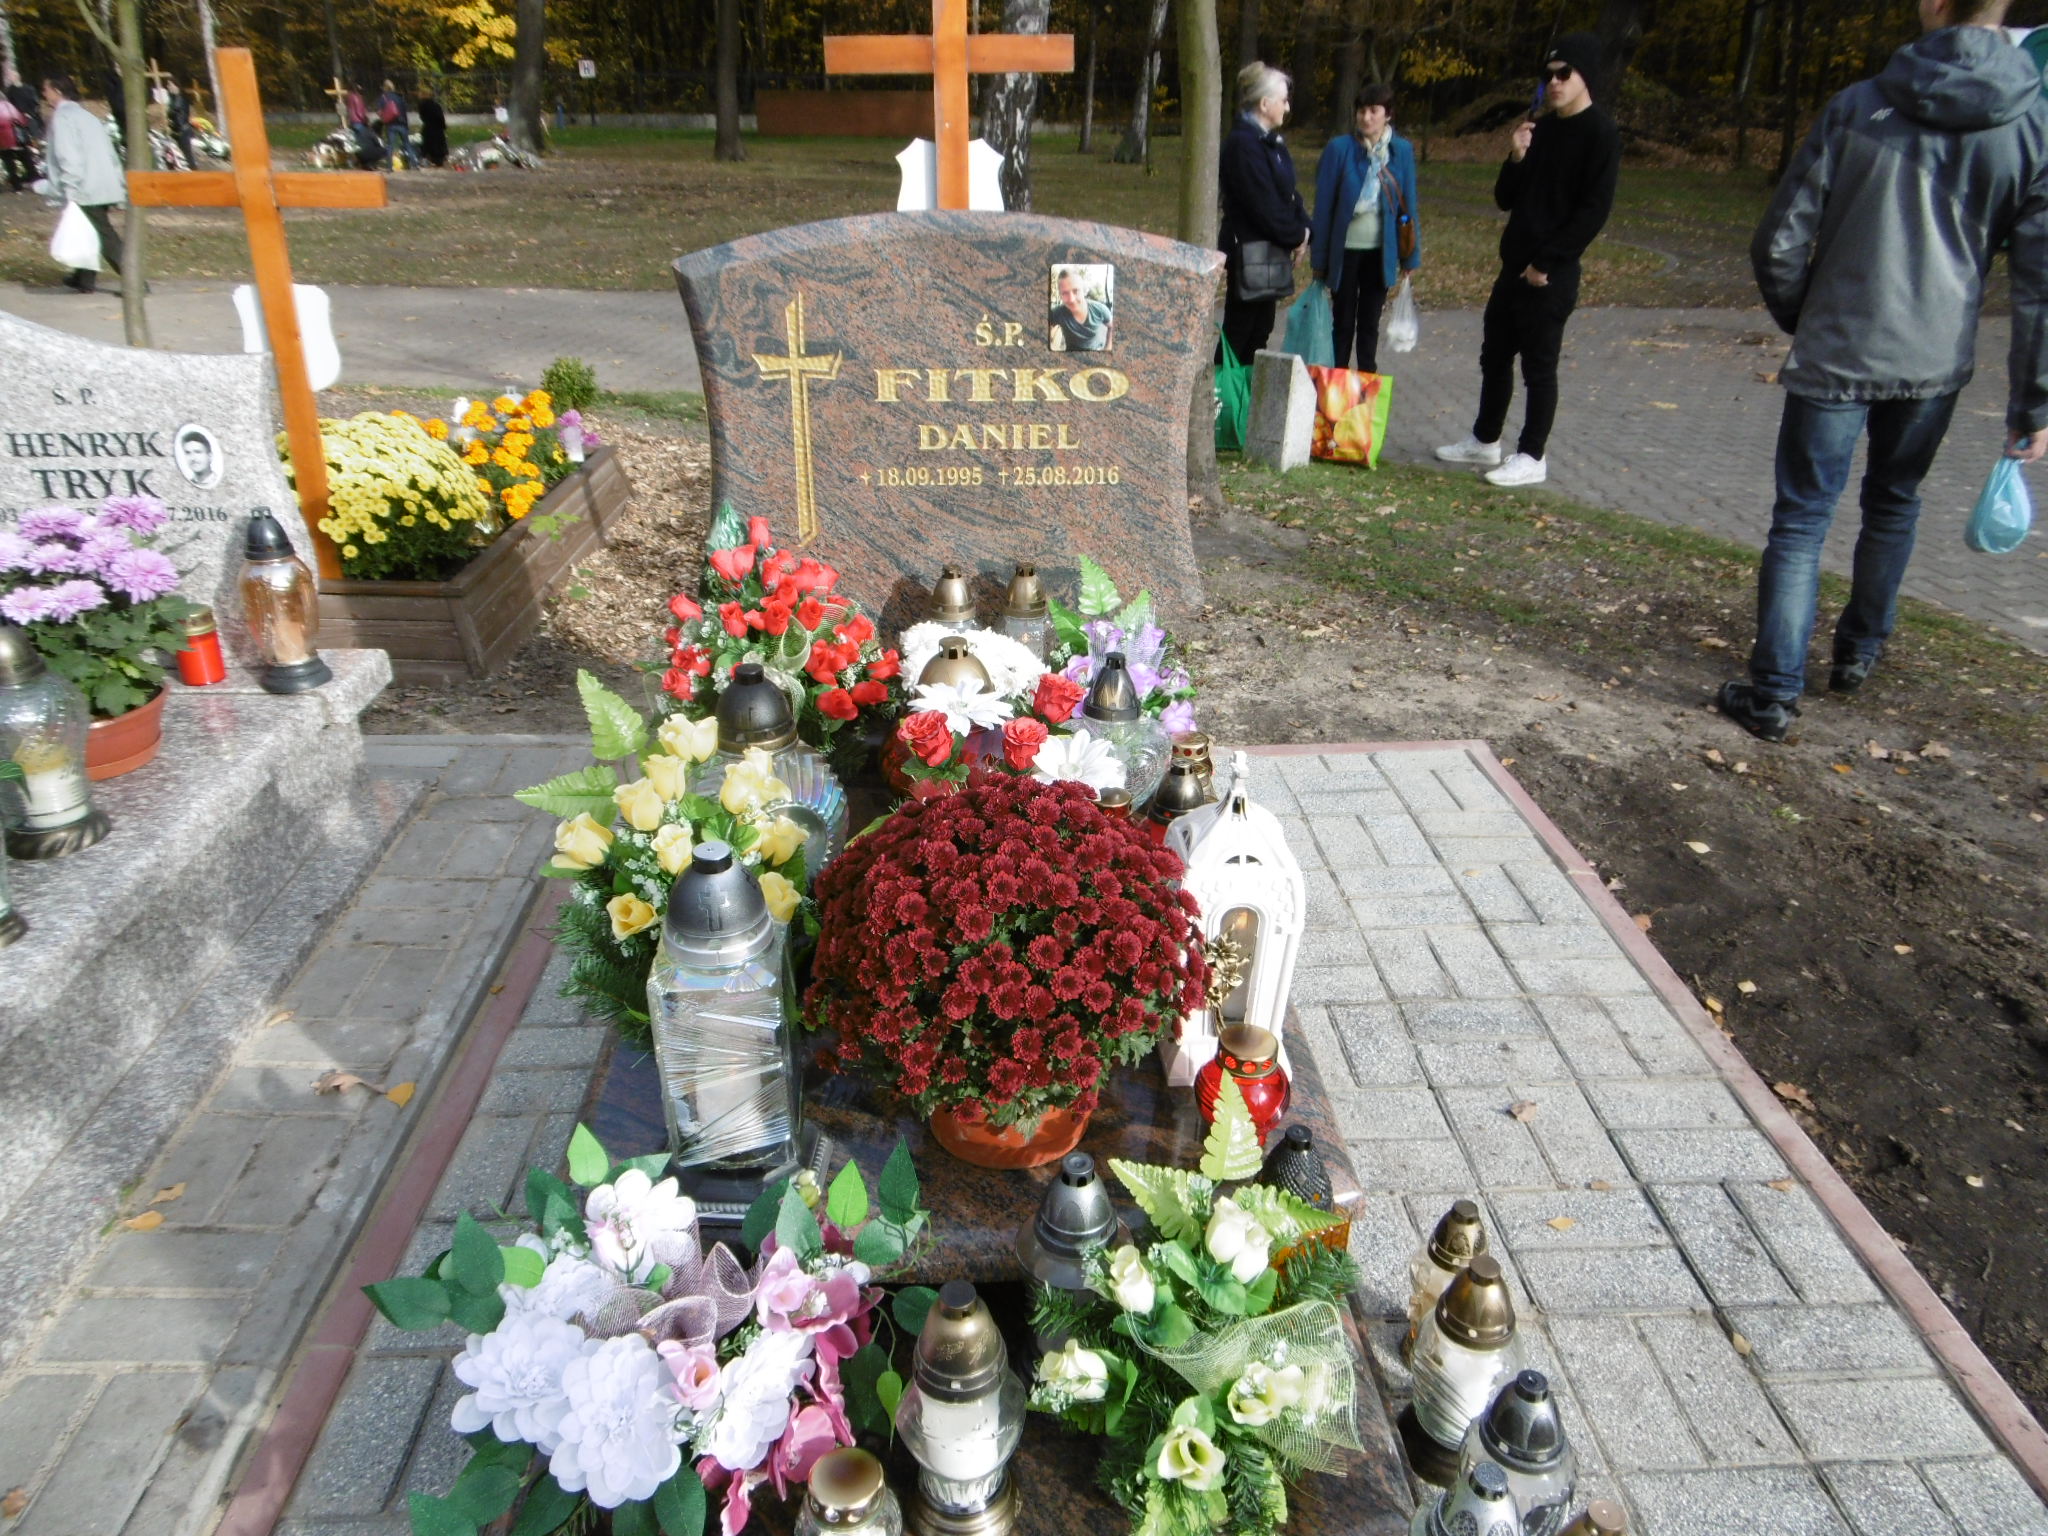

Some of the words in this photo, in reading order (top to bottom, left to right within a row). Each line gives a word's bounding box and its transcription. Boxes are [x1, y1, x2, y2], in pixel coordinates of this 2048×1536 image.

[975, 314, 1024, 347] Ś.P.
[873, 367, 1131, 402] FITKO
[5, 431, 165, 458] HENRYK
[917, 423, 1081, 451] DANIEL
[31, 468, 161, 500] TRYK
[876, 466, 983, 487] 18.09.1995
[1012, 465, 1120, 487] 25.08.2016
